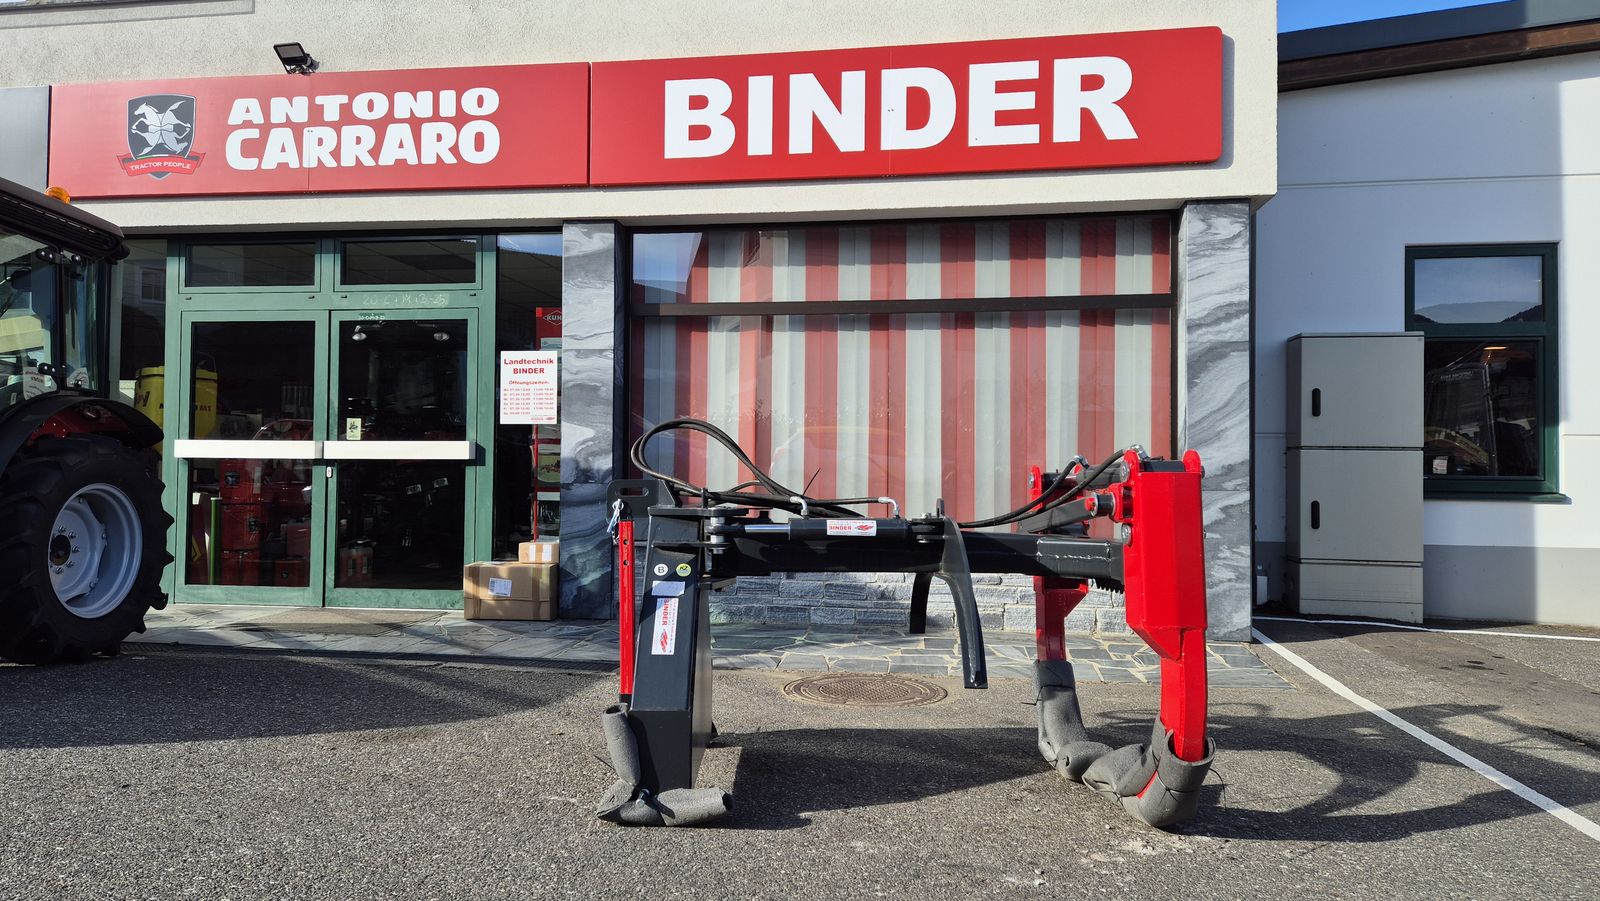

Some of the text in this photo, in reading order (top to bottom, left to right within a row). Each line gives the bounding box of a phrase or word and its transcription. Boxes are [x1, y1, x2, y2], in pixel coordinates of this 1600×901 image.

[227, 87, 500, 125] ANTONIO
[664, 56, 1139, 159] BINDER
[225, 119, 501, 170] CARRARO
[130, 161, 192, 171] TRACTOR PEOPLE
[513, 367, 545, 375] BINDER
[657, 566, 666, 574] B
[661, 598, 671, 627] BINDER
